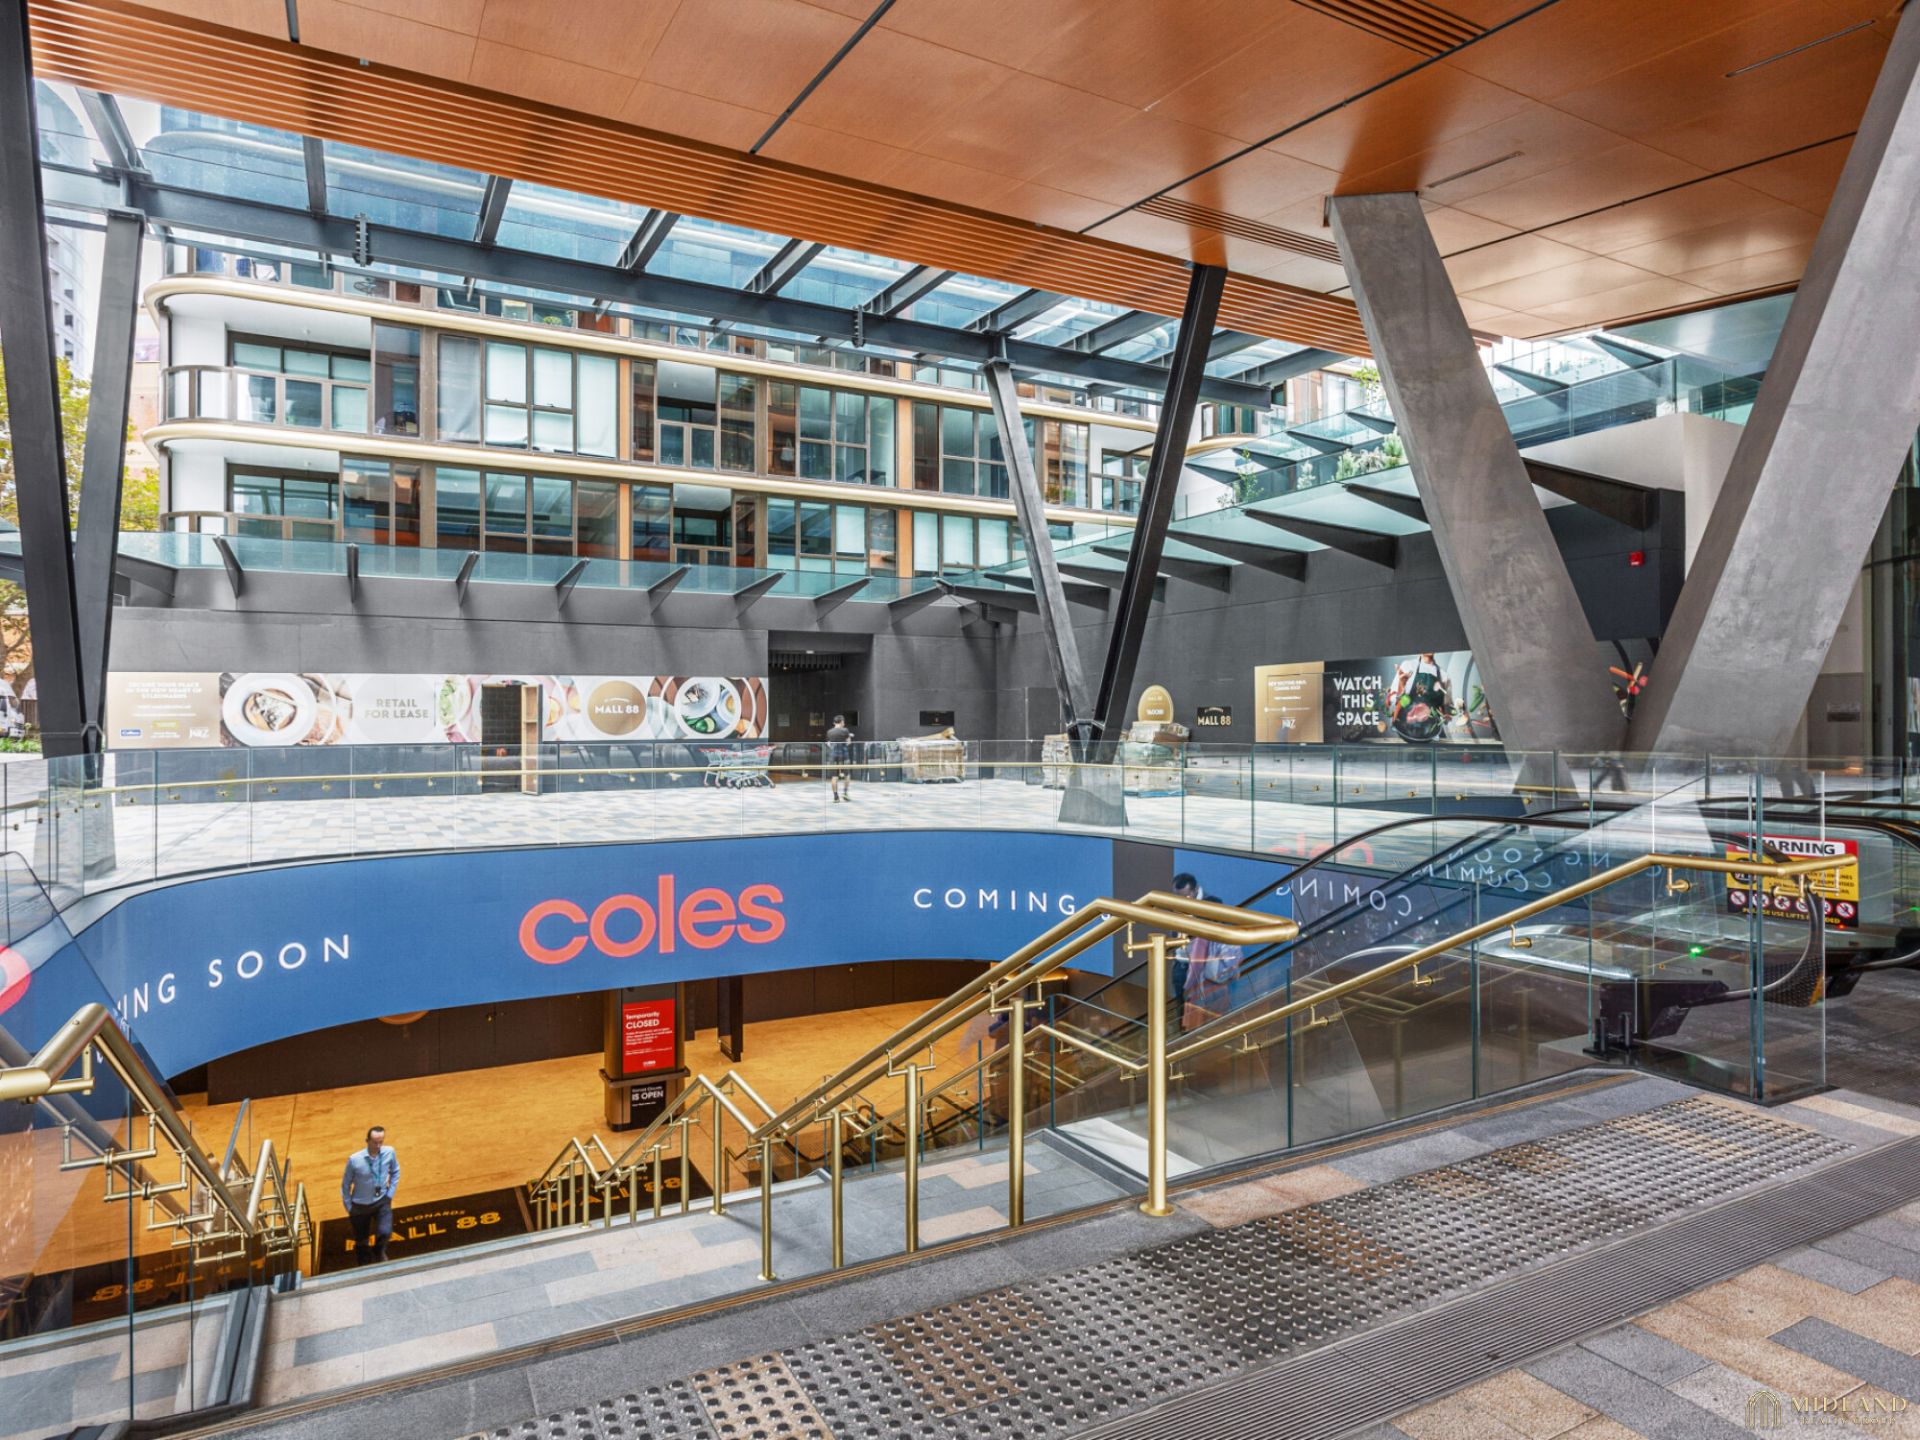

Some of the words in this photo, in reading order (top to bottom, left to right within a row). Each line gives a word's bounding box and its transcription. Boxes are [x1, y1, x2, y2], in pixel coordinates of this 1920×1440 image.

[1333, 675, 1381, 691] WATCH
[376, 699, 417, 708] RETAIL
[1342, 694, 1374, 708] THIS
[364, 709, 389, 719] FOR
[393, 709, 429, 719] LEASE
[595, 704, 624, 714] MALL
[625, 704, 640, 714] 88
[1197, 716, 1218, 726] MALL
[1220, 715, 1232, 726] 88
[1337, 711, 1380, 726] SPACE
[1766, 840, 1835, 855] ARNING
[913, 888, 1075, 916] COMING
[518, 874, 786, 965] coles
[208, 934, 349, 988] SOON
[626, 1011, 660, 1020] Temporarily
[626, 1019, 660, 1029] CLOSED
[632, 1093, 640, 1101] IS
[641, 1090, 664, 1100] OPEN
[399, 1210, 466, 1224] LEONARDS
[456, 1212, 502, 1230] 88
